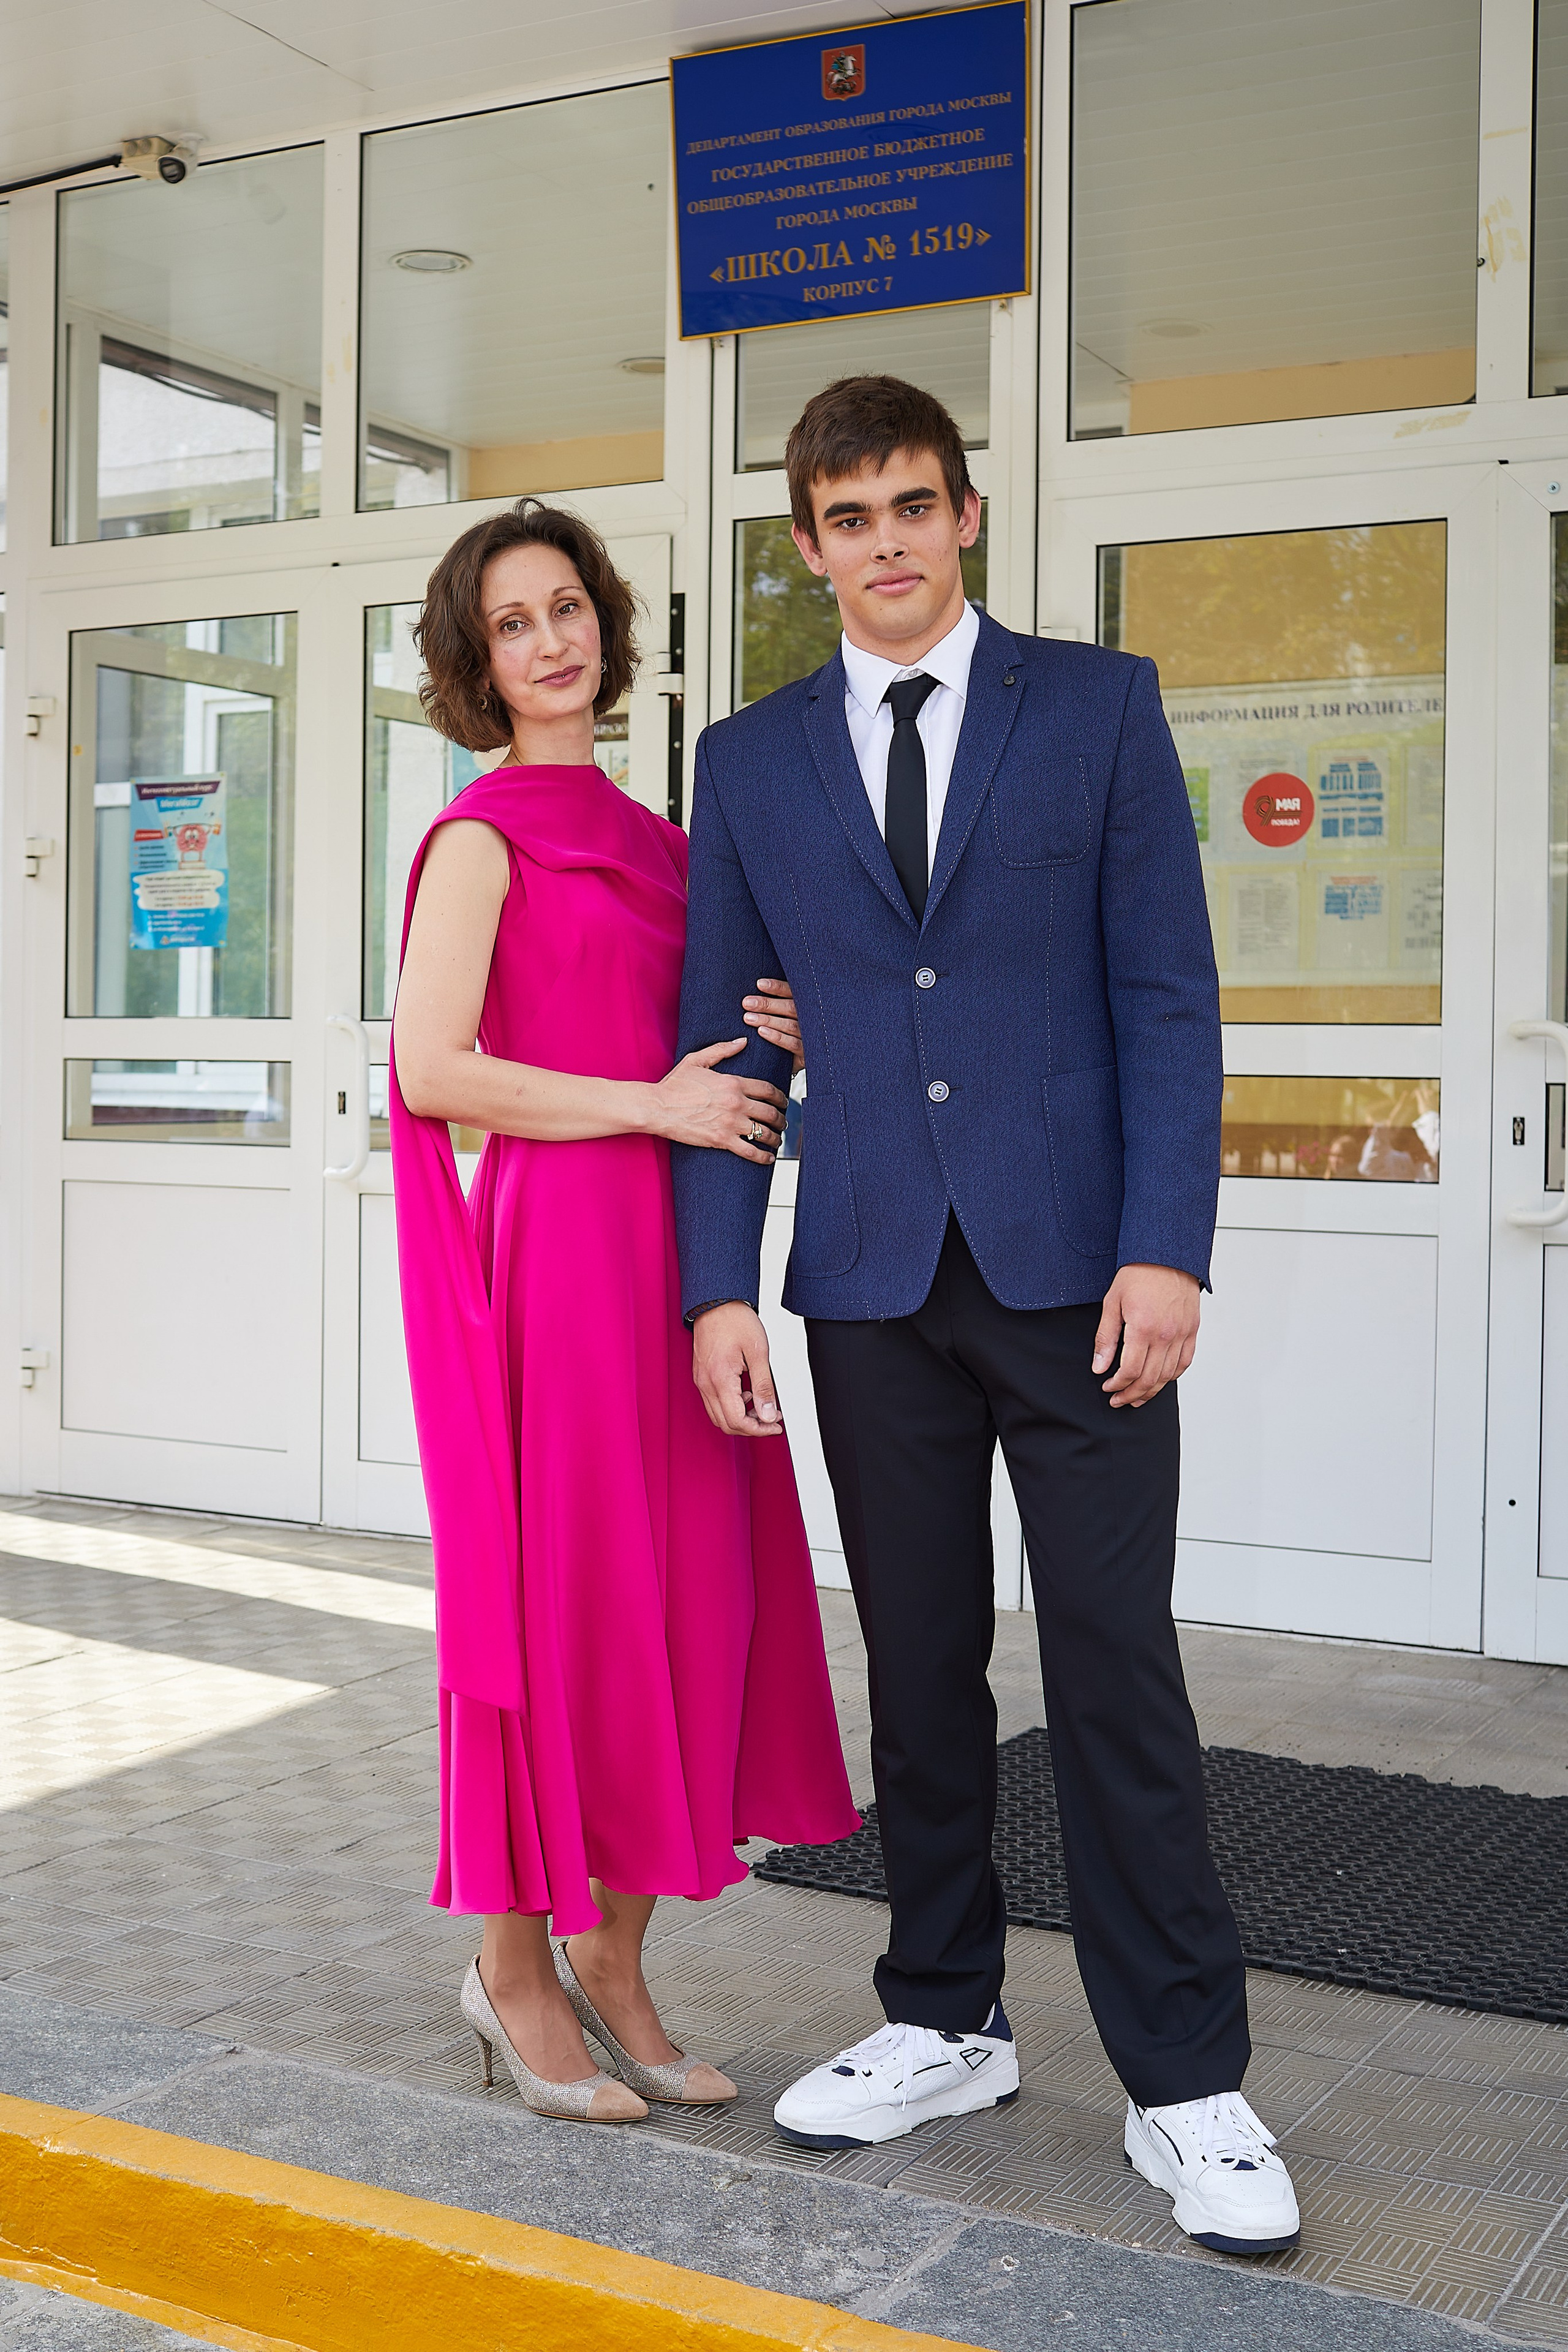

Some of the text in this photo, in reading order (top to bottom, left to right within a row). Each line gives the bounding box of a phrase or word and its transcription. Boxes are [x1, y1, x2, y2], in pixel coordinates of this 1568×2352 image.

[685, 91, 1012, 155] ДЕПАРТАМЕНТ ОБРАЗОВАНИЯ ГОРОДА МОСКВЫ
[710, 127, 986, 183] ГОСУДАРСТВЕННОЕ БЮДЖЕТНОЕ
[687, 153, 1014, 214] ОБЩЕОБРАЗОВАТЕЛЬНОЕ УЧРЕЖДЕНИЕ
[775, 196, 918, 230] ГОРОДА МОСКВЫ
[709, 222, 992, 283] «ШКОЛА № 1519»
[802, 276, 894, 303] КОРПУС 7
[1170, 704, 1299, 725] ИНФОРМАЦИЯ
[1303, 702, 1341, 719] ДЛЯ
[1275, 797, 1301, 811] МАЯ
